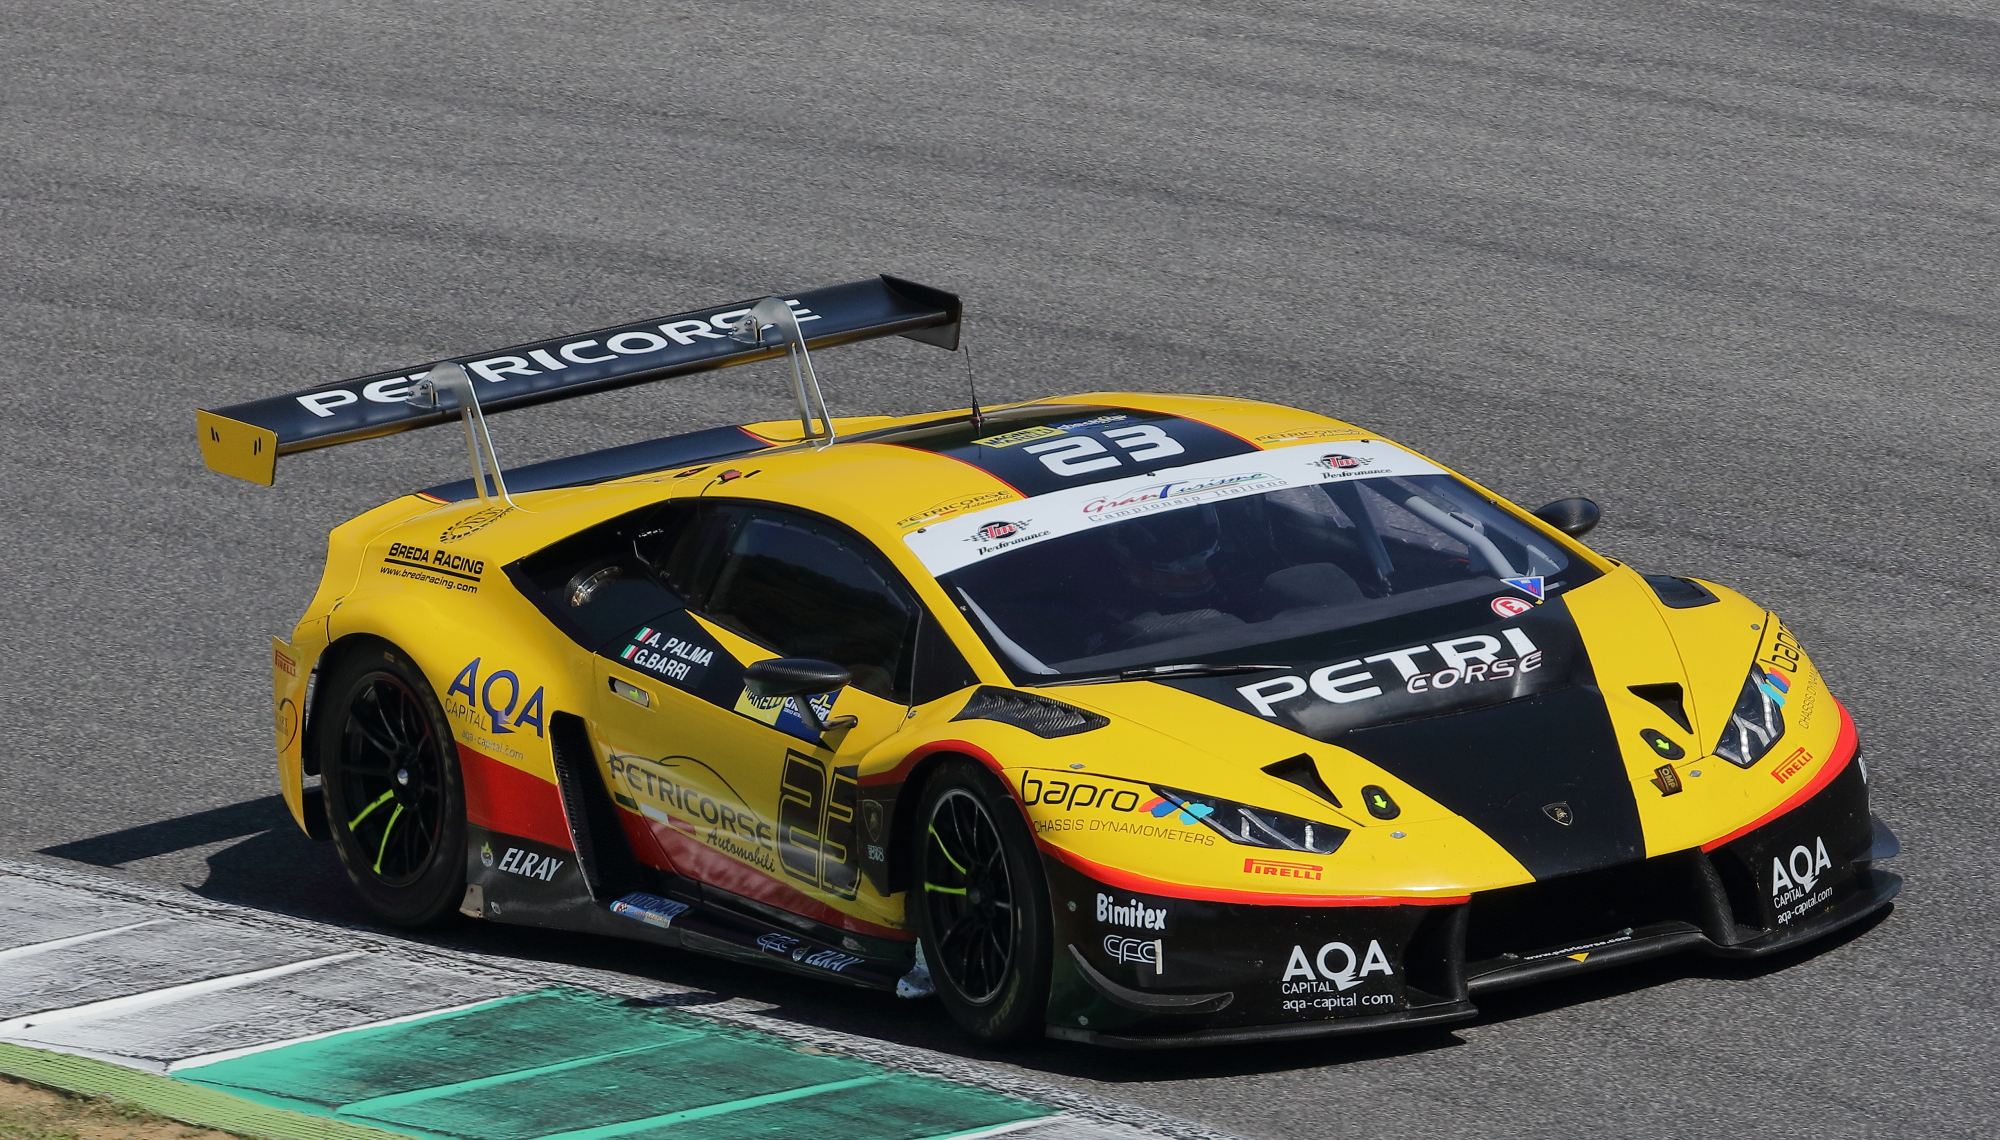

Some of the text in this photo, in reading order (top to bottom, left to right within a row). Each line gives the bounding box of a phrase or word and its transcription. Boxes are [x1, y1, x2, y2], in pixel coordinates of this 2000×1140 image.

[1022, 424, 1185, 477] 23
[1321, 468, 1392, 479] Performance
[896, 489, 1010, 526] PETRICORSE
[962, 494, 1014, 511] Automobili
[1089, 480, 1289, 522] Campionato Italiano
[388, 542, 485, 575] BREDA RACING
[976, 530, 1052, 556] Performance
[379, 565, 478, 594] www.bredaracing.com
[275, 649, 297, 678] PIRELLI
[633, 649, 692, 682] G.BARRI
[644, 632, 714, 668] A. PALMA
[1235, 627, 1538, 718] PETRI
[1405, 649, 1543, 694] CORSE
[445, 697, 487, 732] CAPITAL
[447, 657, 545, 739] AQA
[461, 729, 525, 761] aqa-capital.com
[1661, 766, 1677, 790] OMP
[1771, 746, 1814, 784] PIRELLI
[607, 753, 773, 851] PETRICORSE
[1021, 769, 1140, 812] bapro
[706, 826, 776, 873] Automobili
[1032, 818, 1216, 847] CHASSIS DYNAMOMETERS
[498, 846, 563, 883] ELRAY
[1244, 858, 1324, 881] PIRELLI
[1772, 835, 1832, 896] AQA
[621, 892, 686, 917] AUTOMAC
[1096, 892, 1168, 931] Bimitex
[1773, 886, 1805, 909] CAPITAL
[1777, 886, 1833, 925] aqa-capital.com
[804, 949, 866, 972] ELRAY
[1281, 939, 1394, 992] AQA
[1523, 935, 1633, 961] www.petricorse.com
[1281, 981, 1335, 994] CAPITAL
